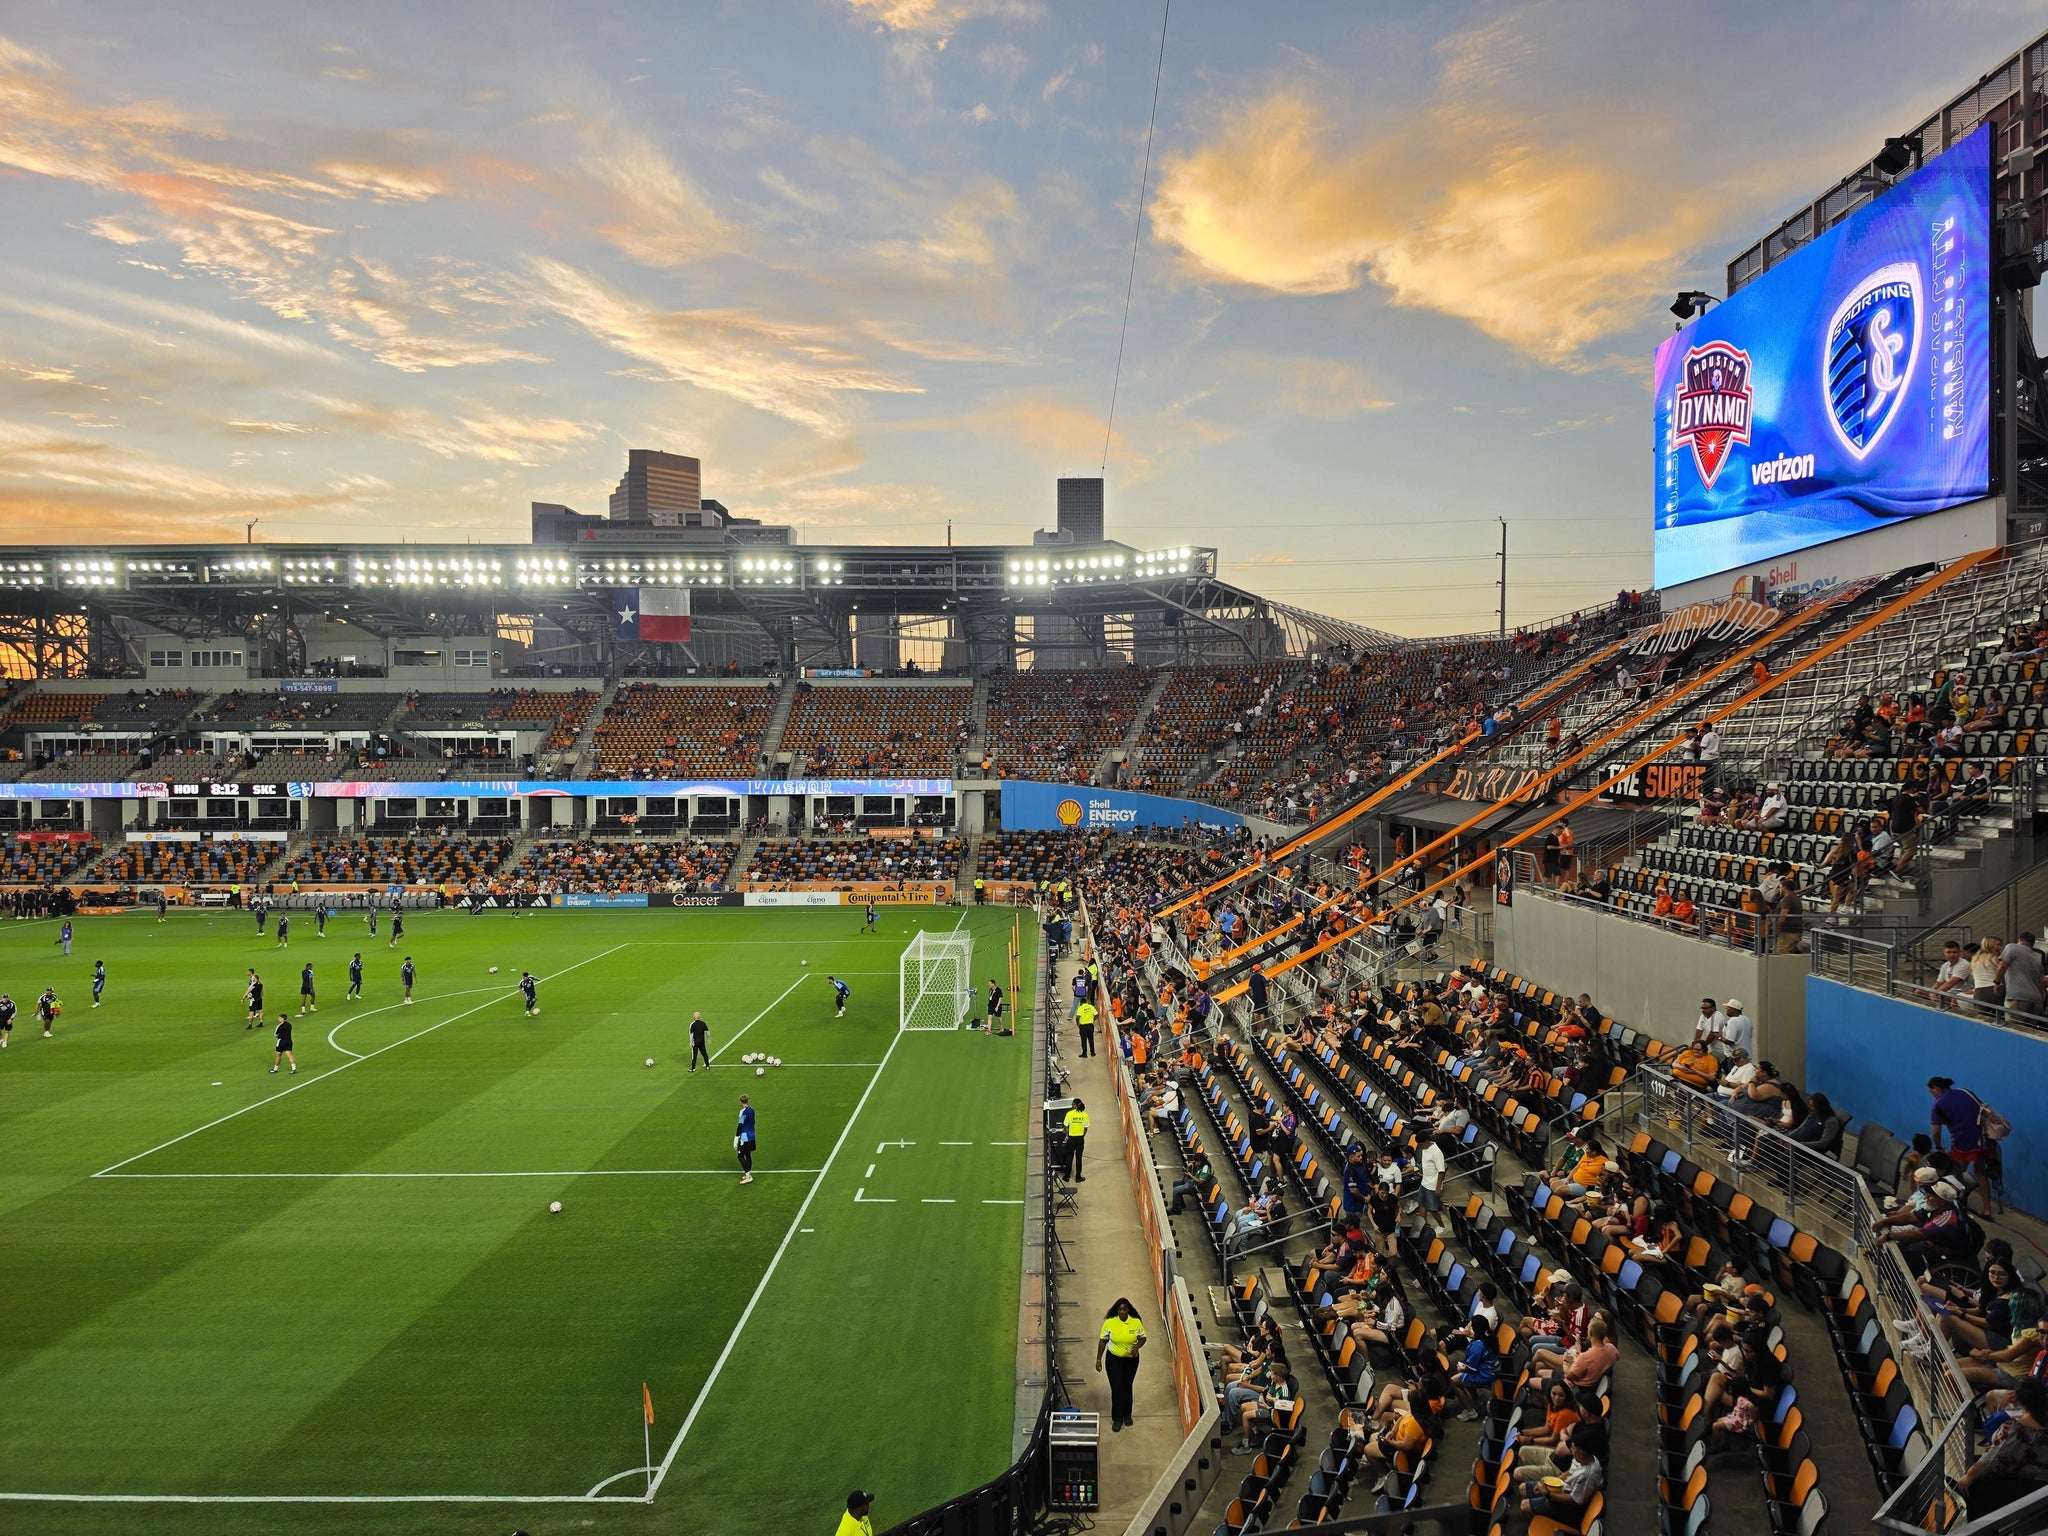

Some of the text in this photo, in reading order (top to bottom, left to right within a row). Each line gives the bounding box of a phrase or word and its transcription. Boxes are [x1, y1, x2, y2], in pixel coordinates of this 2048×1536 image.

[1832, 284, 1911, 343] SPORTING
[1693, 355, 1741, 377] HOUSTON
[1680, 394, 1747, 430] DYNAMO
[1751, 452, 1815, 486] verizon
[2029, 522, 2042, 534] 217
[1769, 561, 1797, 587] Shell
[173, 784, 199, 795] HOU
[210, 783, 240, 796] 8:12
[252, 784, 277, 795] SKC
[1607, 763, 1707, 800] THE SURGE
[1089, 799, 1111, 809] Shell
[1089, 809, 1138, 822] ENERGY
[672, 893, 720, 907] Cancer
[848, 892, 929, 904] Continental Tire
